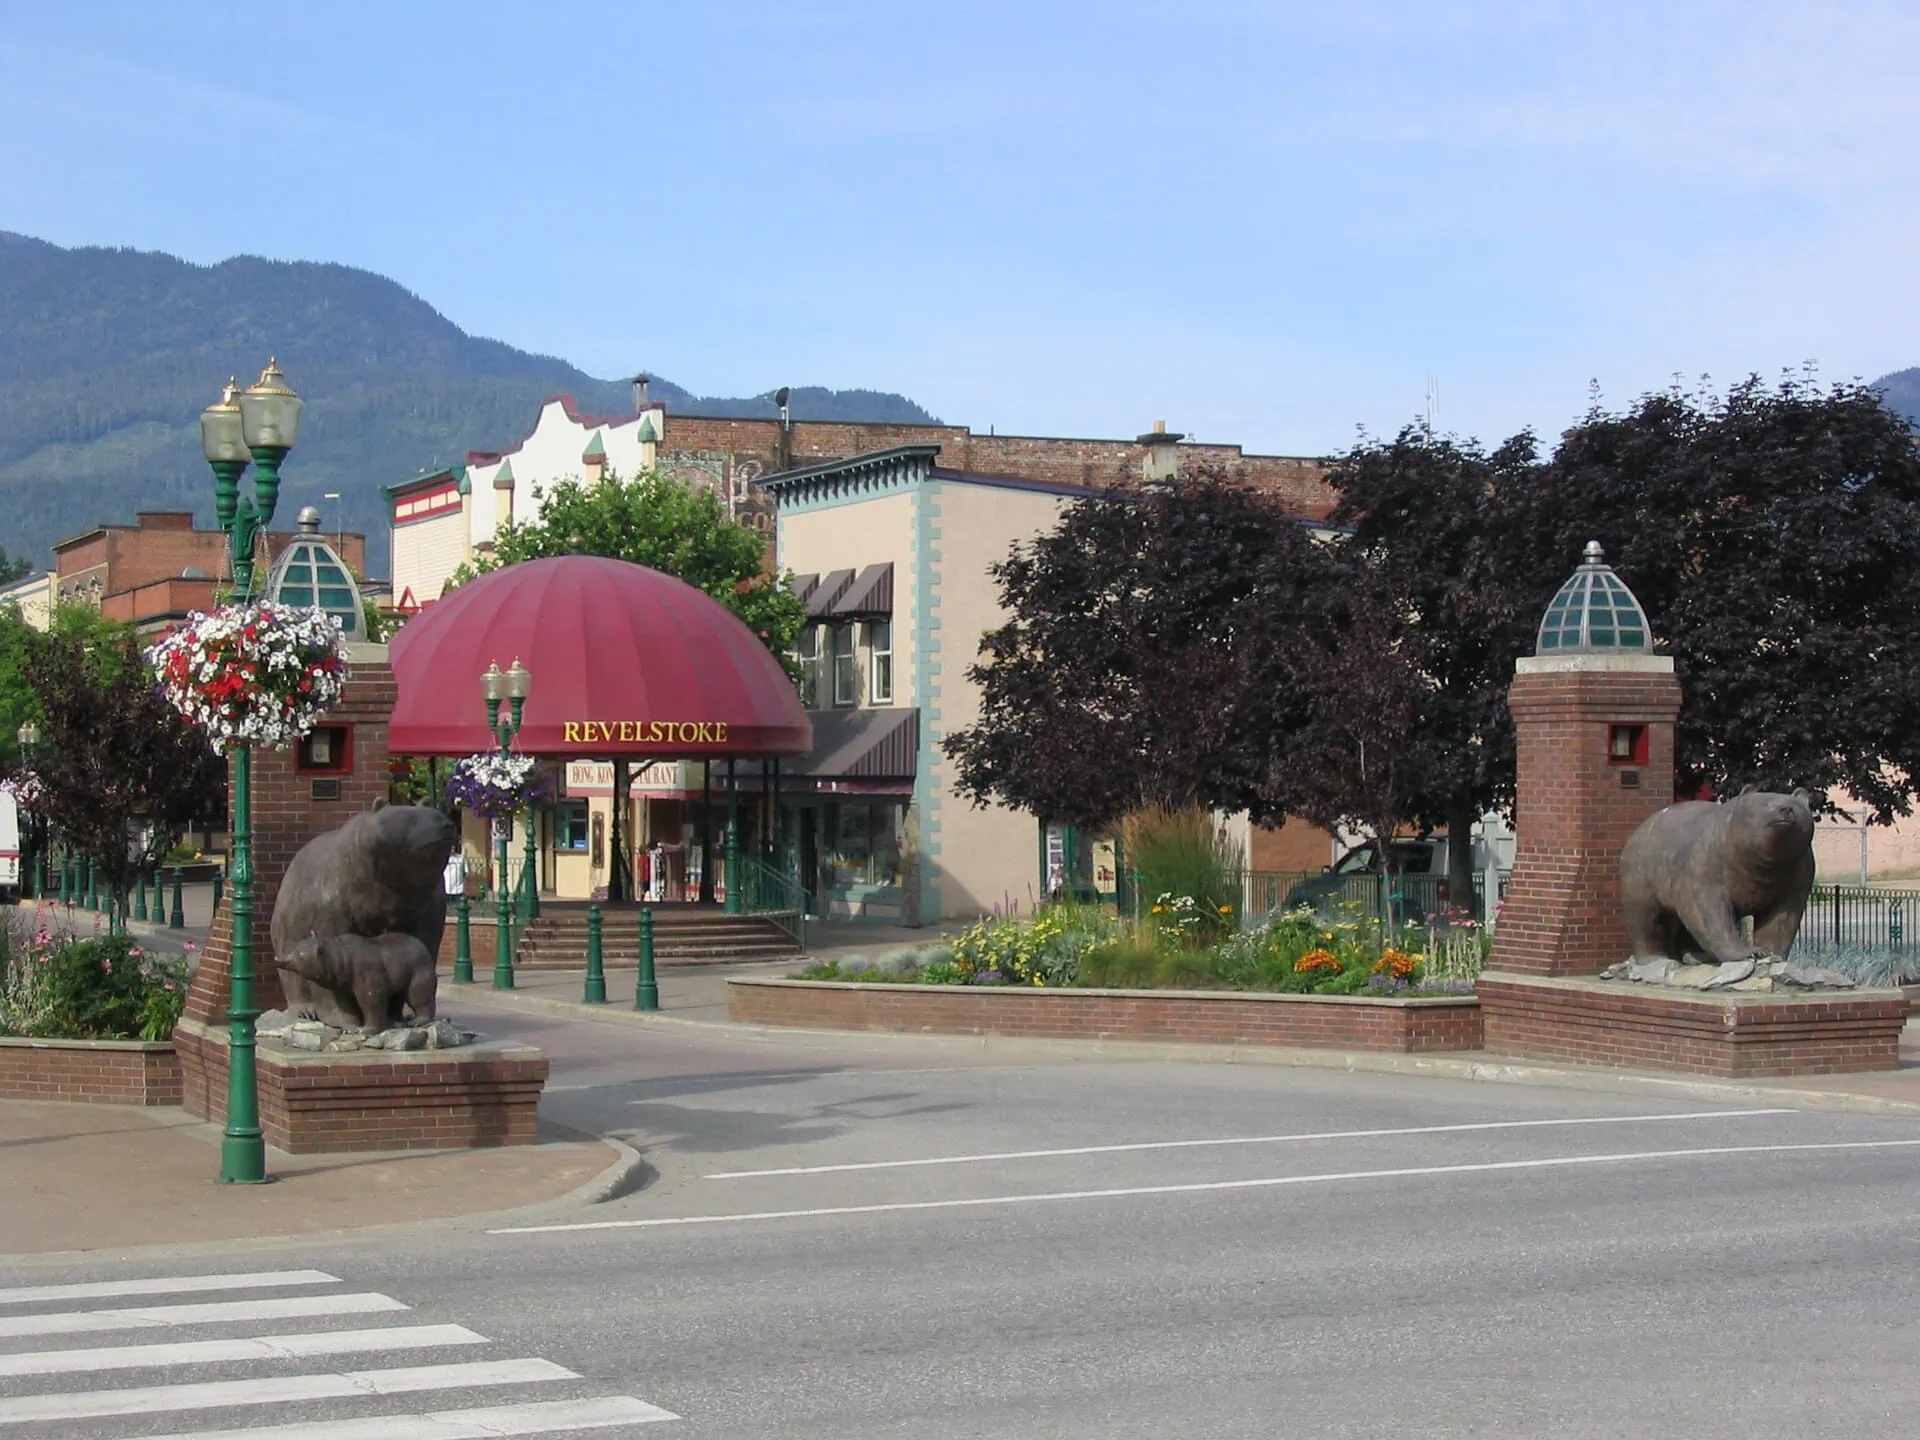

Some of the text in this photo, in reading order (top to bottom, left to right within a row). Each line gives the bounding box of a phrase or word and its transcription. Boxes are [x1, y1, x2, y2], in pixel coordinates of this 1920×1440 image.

[563, 720, 728, 743] REVELSTOKE
[572, 766, 677, 785] HONG KON STAURANT
